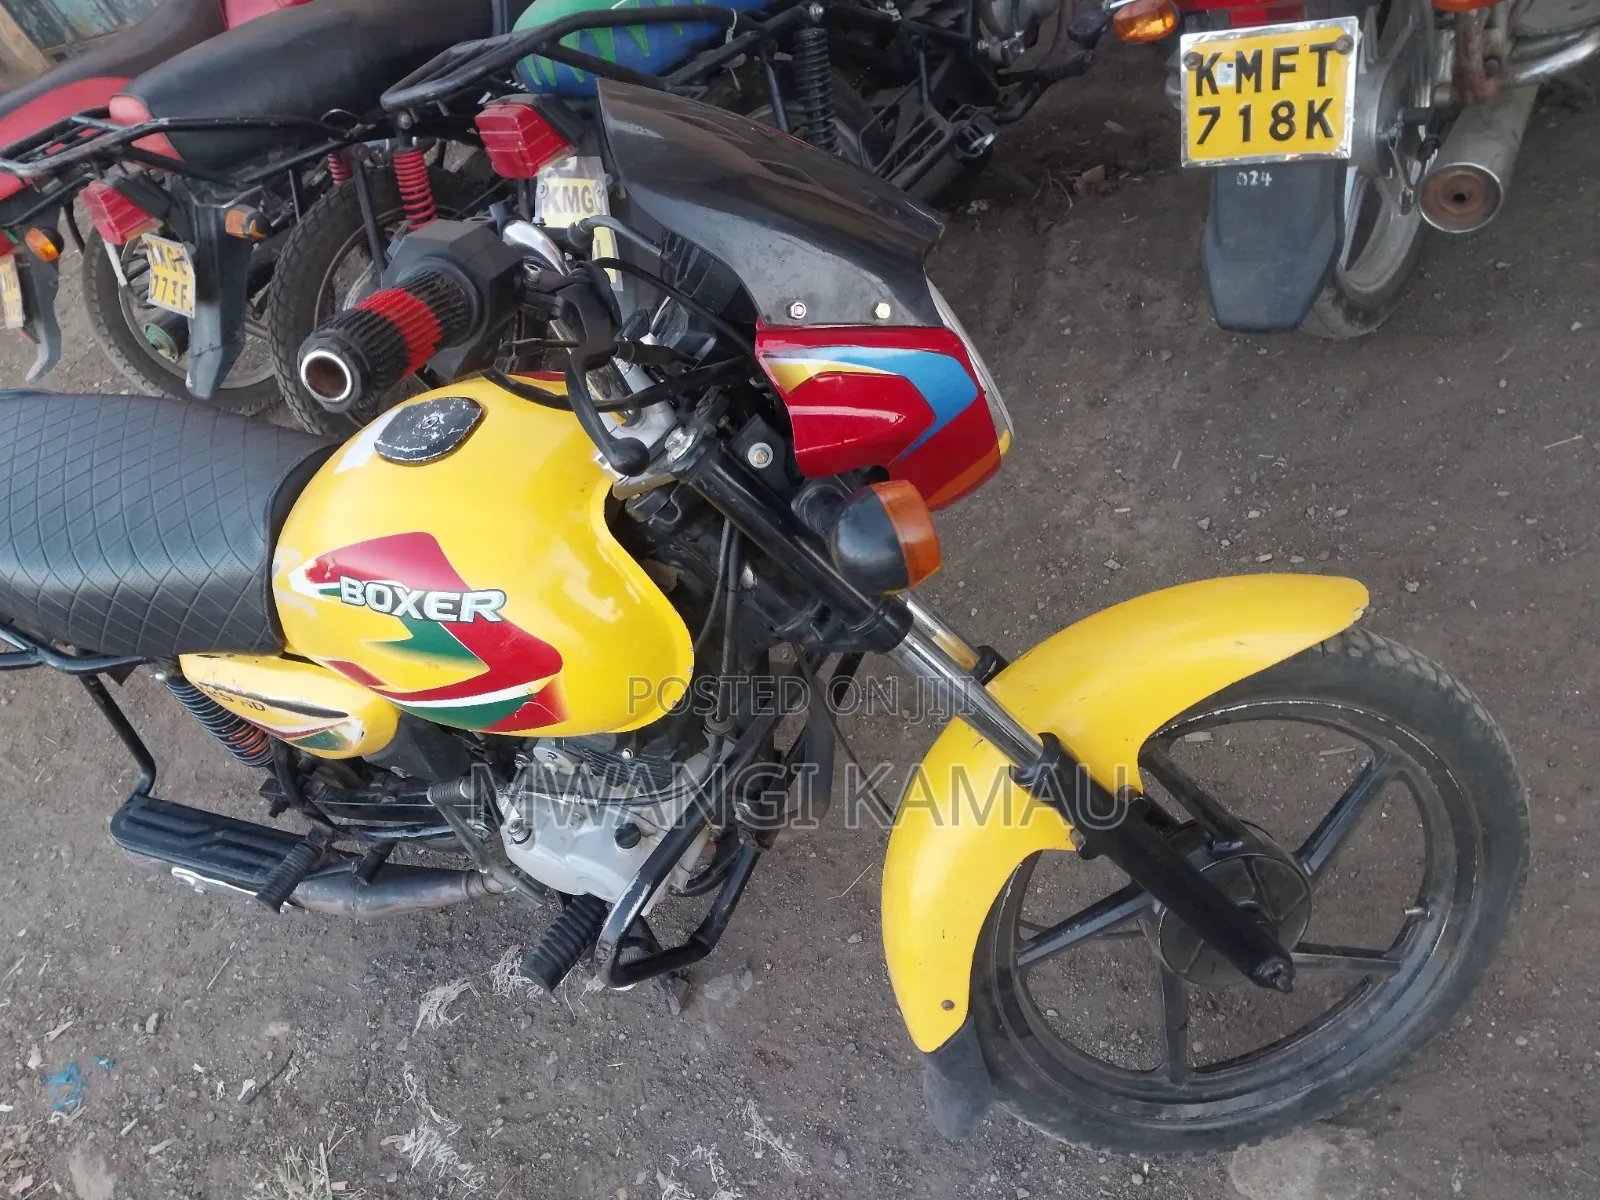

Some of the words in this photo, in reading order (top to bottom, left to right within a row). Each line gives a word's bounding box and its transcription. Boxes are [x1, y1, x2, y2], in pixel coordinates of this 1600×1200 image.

[1195, 42, 1342, 97] KMFT
[1196, 97, 1334, 145] 718K
[339, 575, 507, 624] BOXER
